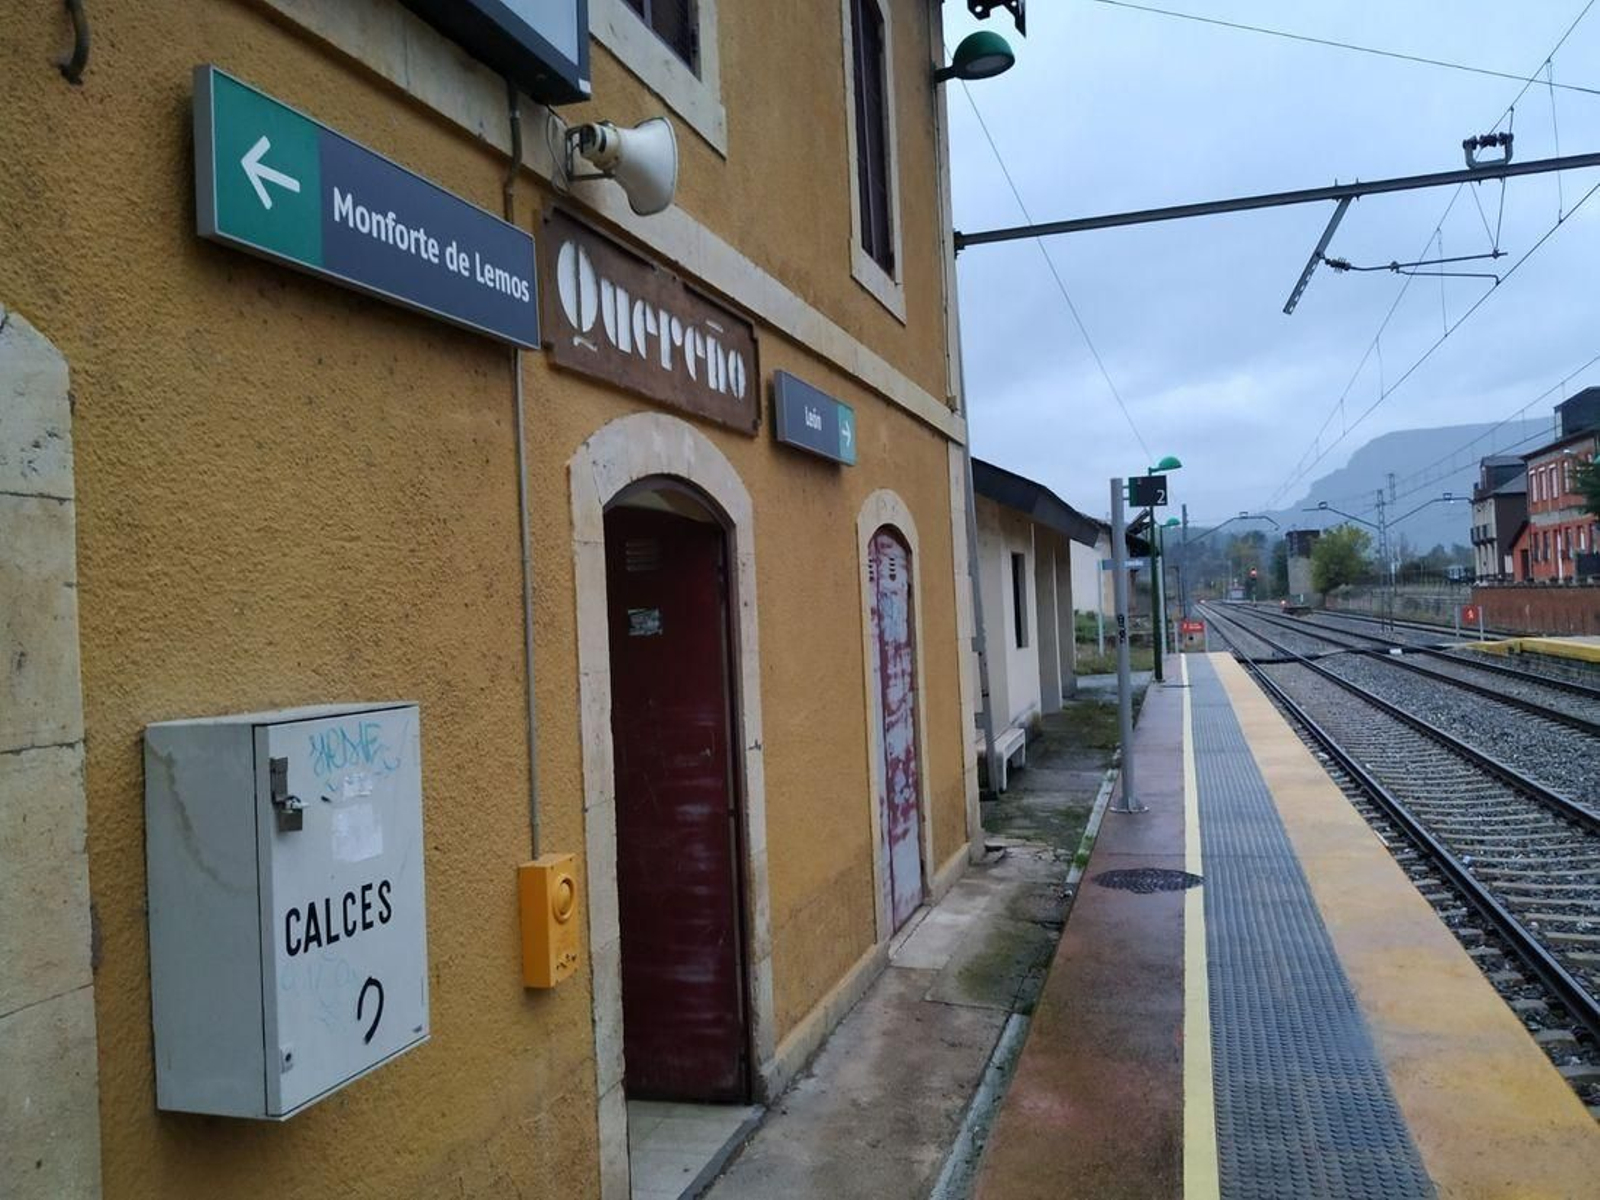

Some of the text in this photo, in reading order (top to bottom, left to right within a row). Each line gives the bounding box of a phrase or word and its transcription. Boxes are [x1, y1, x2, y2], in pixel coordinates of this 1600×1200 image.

[333, 186, 530, 303] Monforte de Lemos
[557, 239, 746, 400] Quereño
[1156, 489, 1166, 503] 2
[285, 880, 392, 957] CALCES
